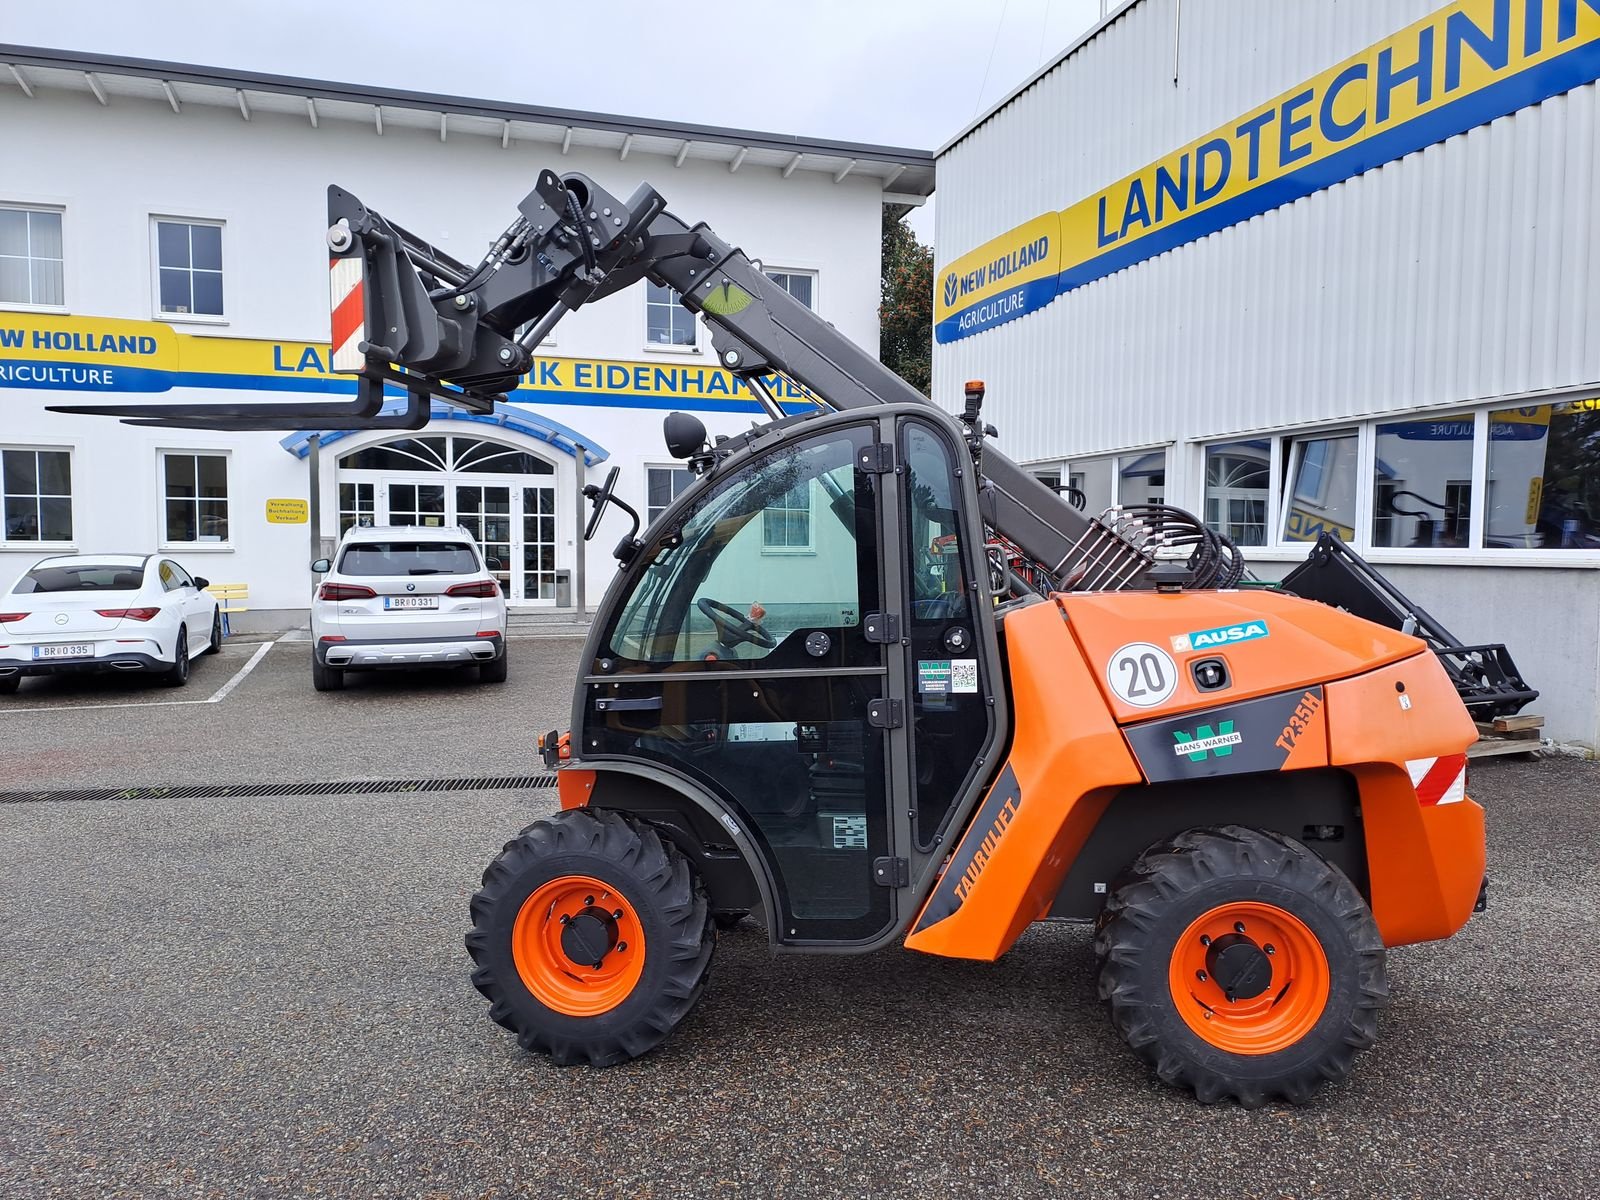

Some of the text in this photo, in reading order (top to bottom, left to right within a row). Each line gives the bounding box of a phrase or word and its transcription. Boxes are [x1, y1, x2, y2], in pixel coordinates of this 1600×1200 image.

[960, 235, 1049, 296] NEW HOLLAND
[958, 290, 1024, 332] AGRICULTURE
[32, 330, 157, 355] HOLLAND
[70, 646, 87, 654] 335
[1193, 624, 1266, 647] AUSA
[1119, 652, 1166, 698] 20
[1275, 691, 1323, 753] T235H
[1176, 734, 1240, 753] HANS WARNER
[954, 797, 1017, 901] TAURULIFT
